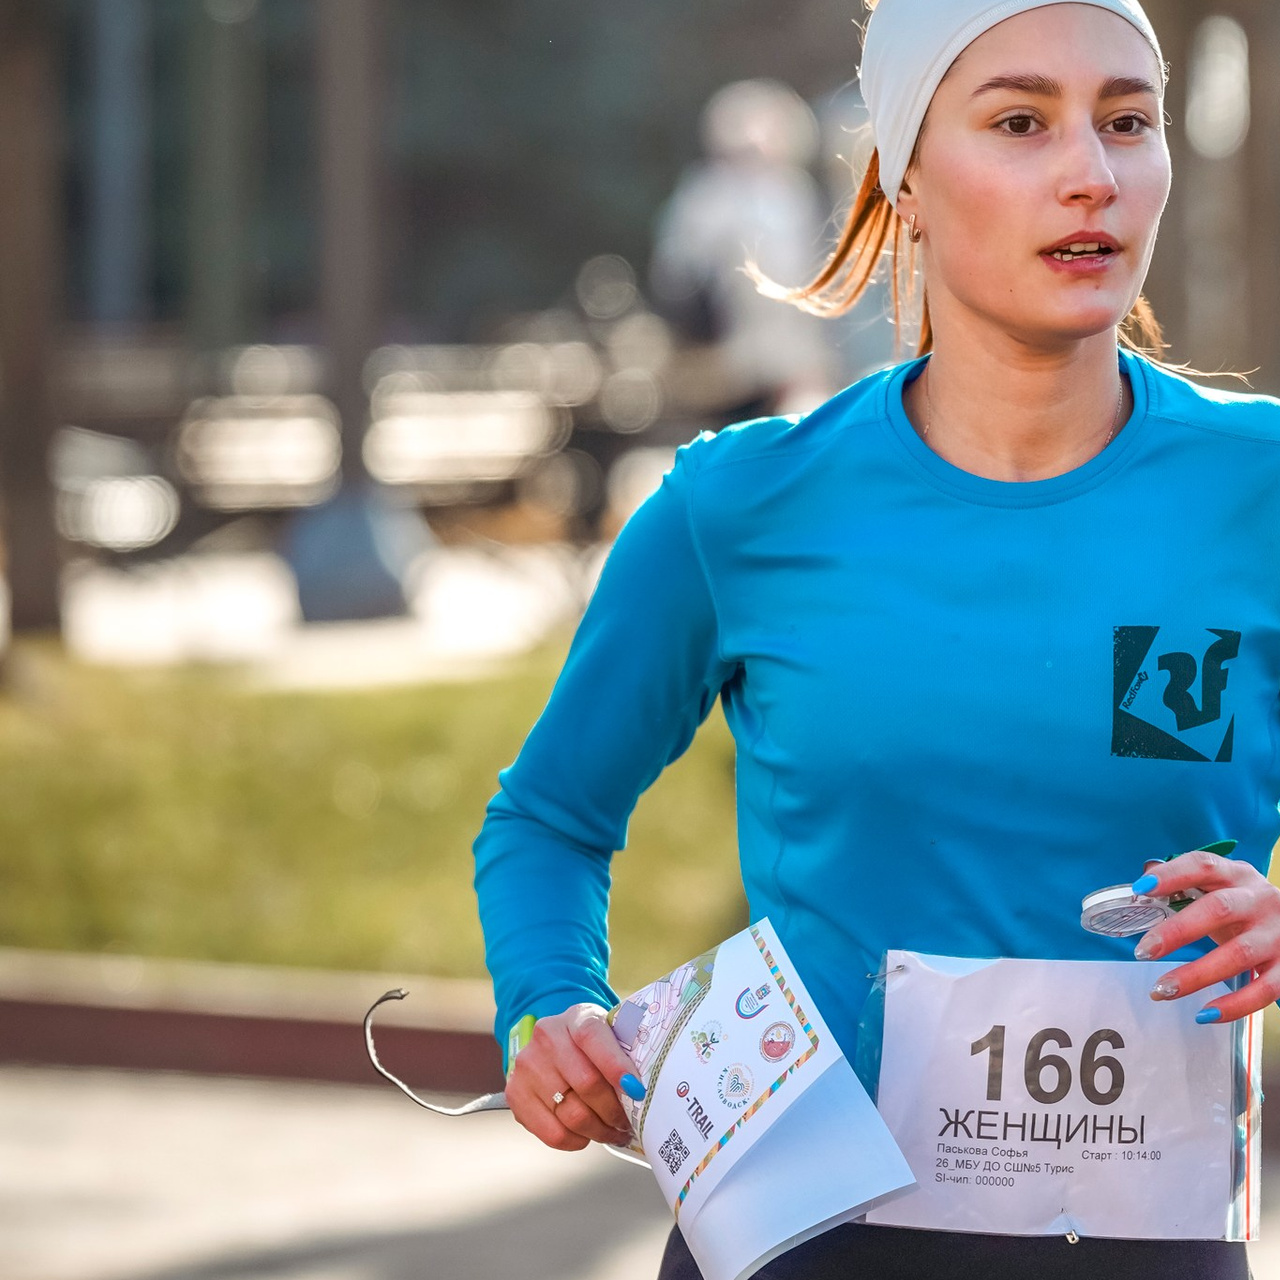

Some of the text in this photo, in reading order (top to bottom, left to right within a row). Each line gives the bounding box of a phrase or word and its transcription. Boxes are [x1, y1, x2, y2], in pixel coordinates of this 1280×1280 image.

[970, 1024, 1125, 1106] 166
[937, 1107, 1146, 1150] ЖЕНЩИНЫ
[936, 1142, 1029, 1159] Паськова Софья
[1081, 1149, 1112, 1162] Старт
[1122, 1149, 1162, 1161] 10:14:00
[935, 1157, 1075, 1176] 26_МБУ ДО СШ№5 Турис
[975, 1174, 1015, 1188] 000000
